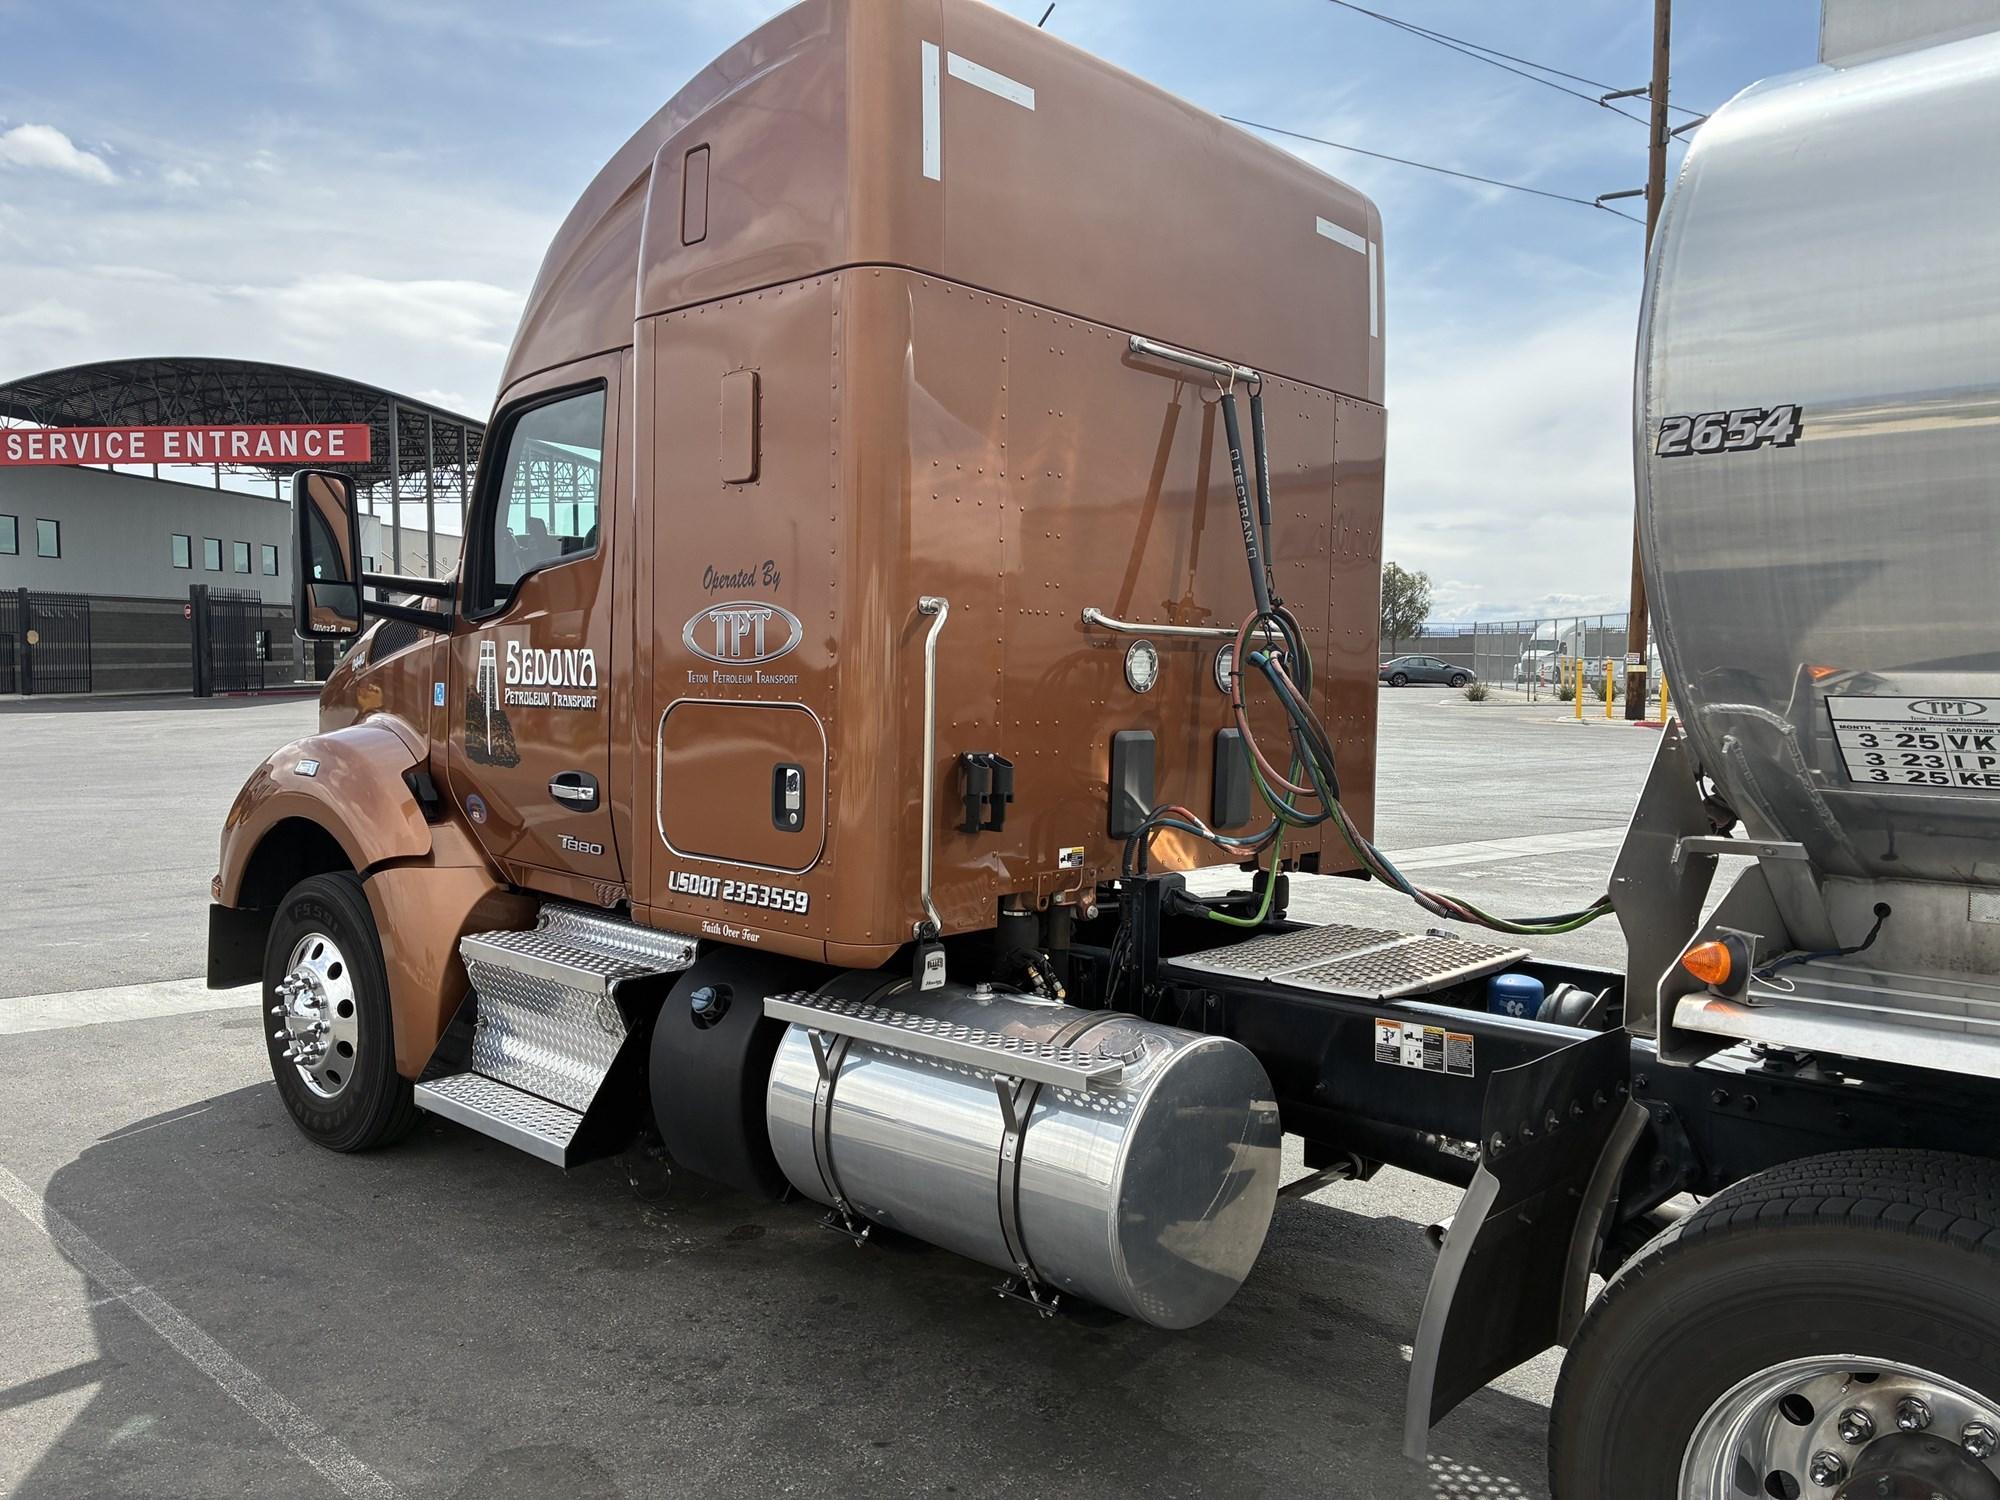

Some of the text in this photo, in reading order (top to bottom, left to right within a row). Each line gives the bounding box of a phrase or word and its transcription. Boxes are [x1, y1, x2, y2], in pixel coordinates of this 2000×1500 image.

[7, 429, 345, 460] SERVICE ENTRANCE
[1656, 405, 1802, 457] 2654
[1232, 464, 1253, 543] TECTRAN
[703, 560, 781, 596] Operated By
[709, 609, 772, 657] TPT
[505, 640, 597, 688] SEDONA
[687, 670, 798, 684] TETON PETROLEUM TRANSPORT
[1926, 702, 1967, 715] TPT
[557, 834, 603, 855] T880
[668, 870, 810, 915] USDOT 2353559
[701, 921, 760, 943] Faith Over Fear
